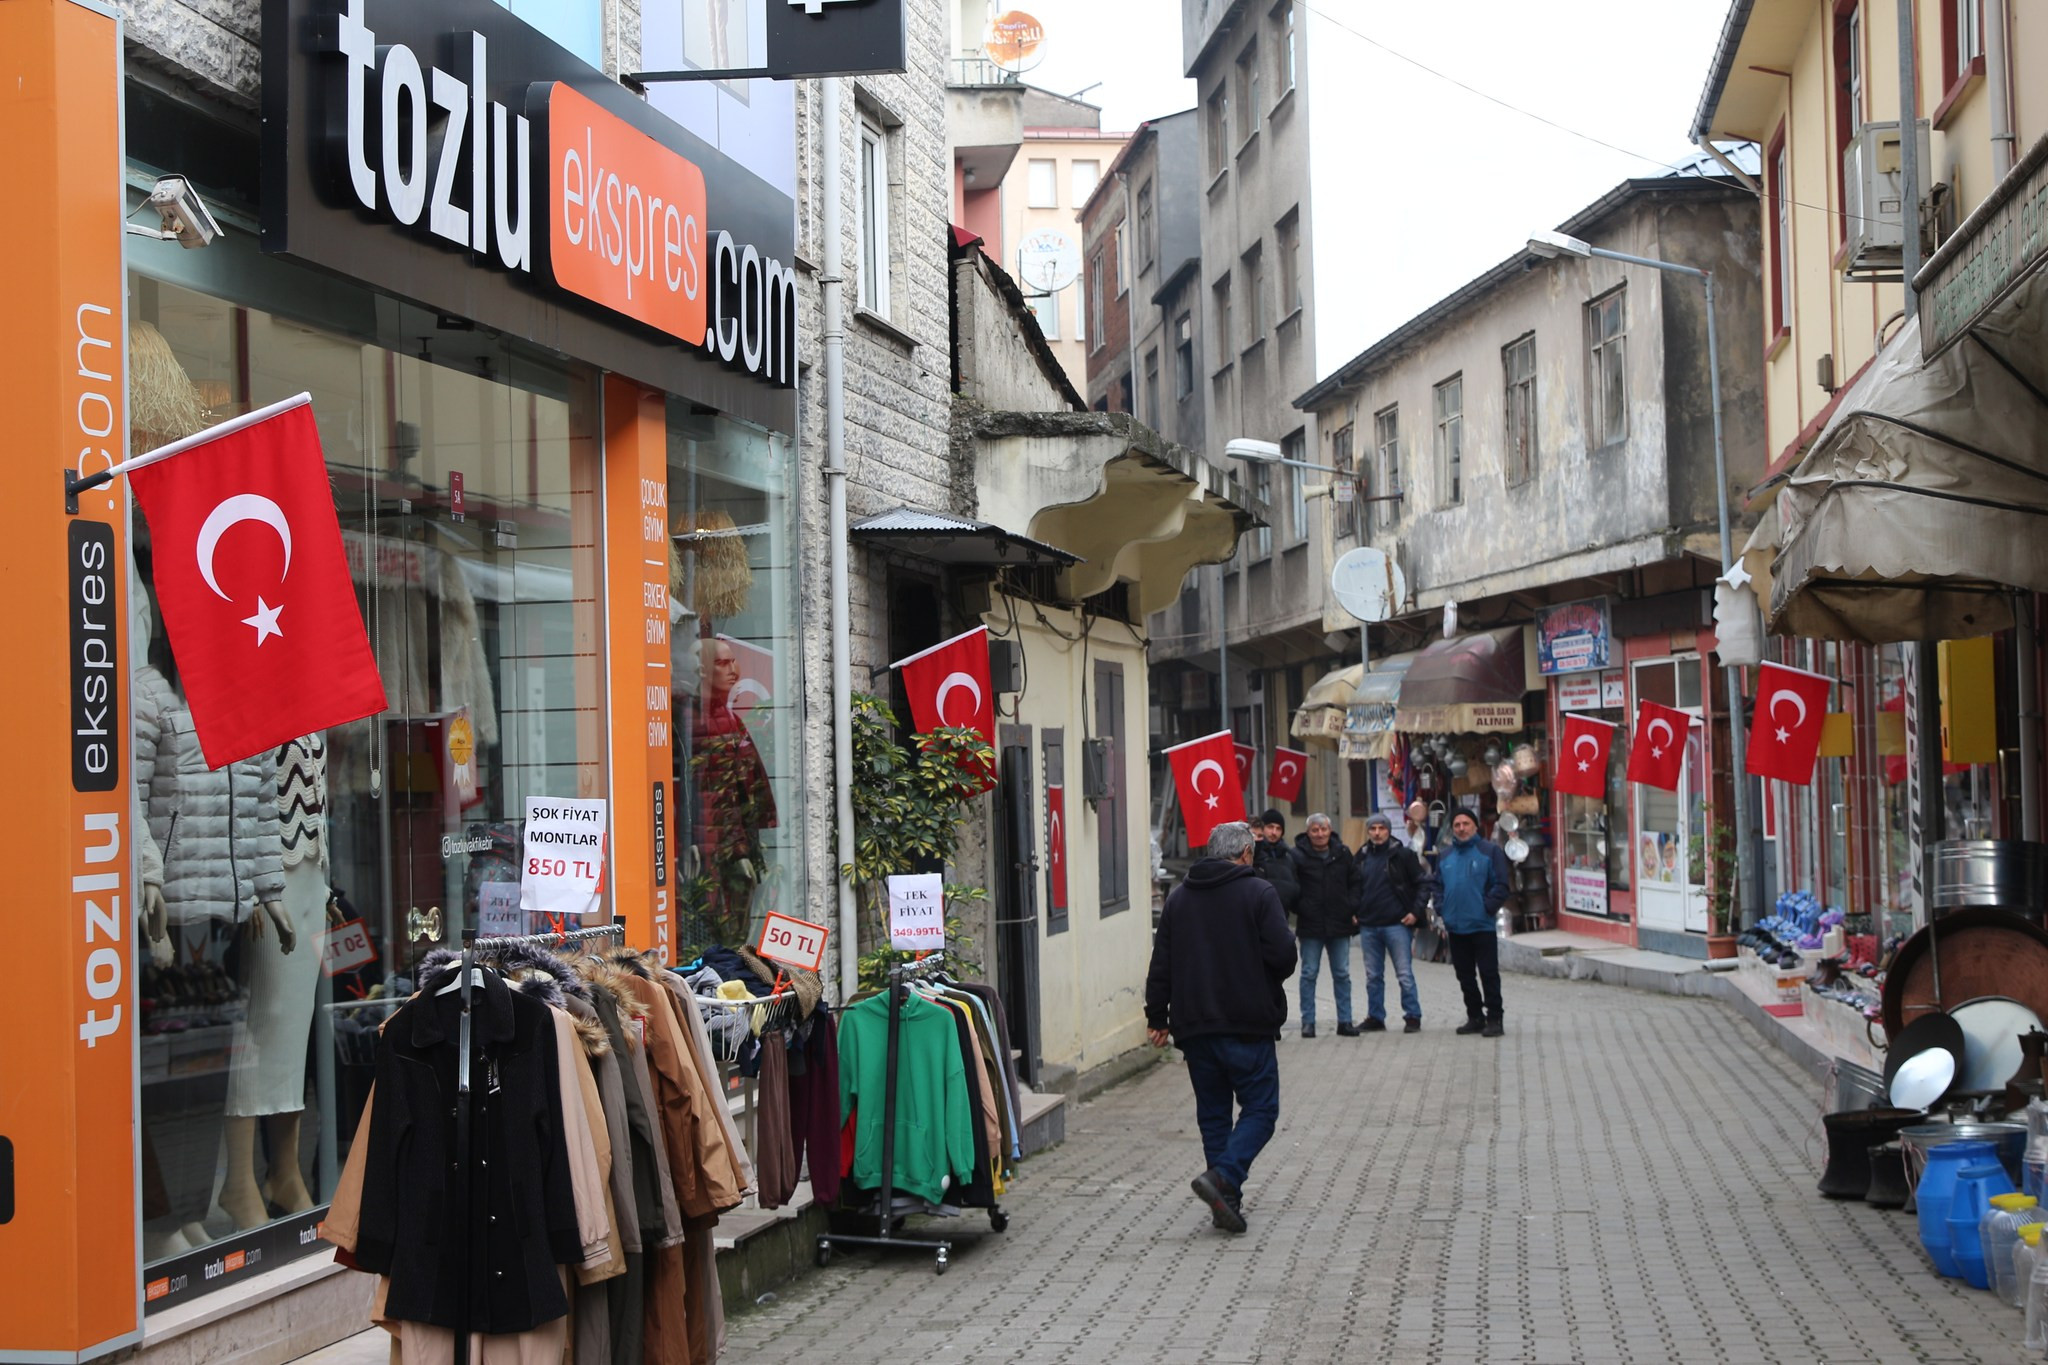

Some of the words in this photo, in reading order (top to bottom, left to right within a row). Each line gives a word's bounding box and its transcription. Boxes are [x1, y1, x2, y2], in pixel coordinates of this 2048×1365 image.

[339, 0, 530, 273] tozlu
[563, 126, 698, 300] ekspres
[706, 230, 798, 389] .com
[76, 303, 115, 510] .com
[641, 478, 666, 509] ÇOCUK
[643, 510, 664, 543] GİYİM
[643, 582, 667, 609] ERKEK
[646, 613, 666, 645] GİYİM
[77, 541, 114, 774] ekspres
[646, 685, 668, 711] KADIN
[648, 716, 668, 747] GİYİM
[1476, 717, 1514, 726] ALINIR
[532, 807, 559, 821] ŞOK
[562, 806, 598, 821] FİYAT
[530, 831, 598, 846] MONTLAR
[655, 788, 665, 880] ekspres
[528, 857, 566, 876] 850
[572, 860, 595, 879] TL
[904, 890, 928, 900] TEK
[900, 906, 935, 917] FİYAT
[72, 812, 122, 1048] tozlu
[655, 890, 669, 966] ozlu
[768, 927, 792, 946] 50
[797, 934, 815, 955] TL
[893, 927, 942, 937] 349.99TL
[299, 1226, 317, 1245] tozlu
[205, 1258, 225, 1280] tozlu
[245, 1248, 262, 1266] .com
[169, 1273, 187, 1293] .com
